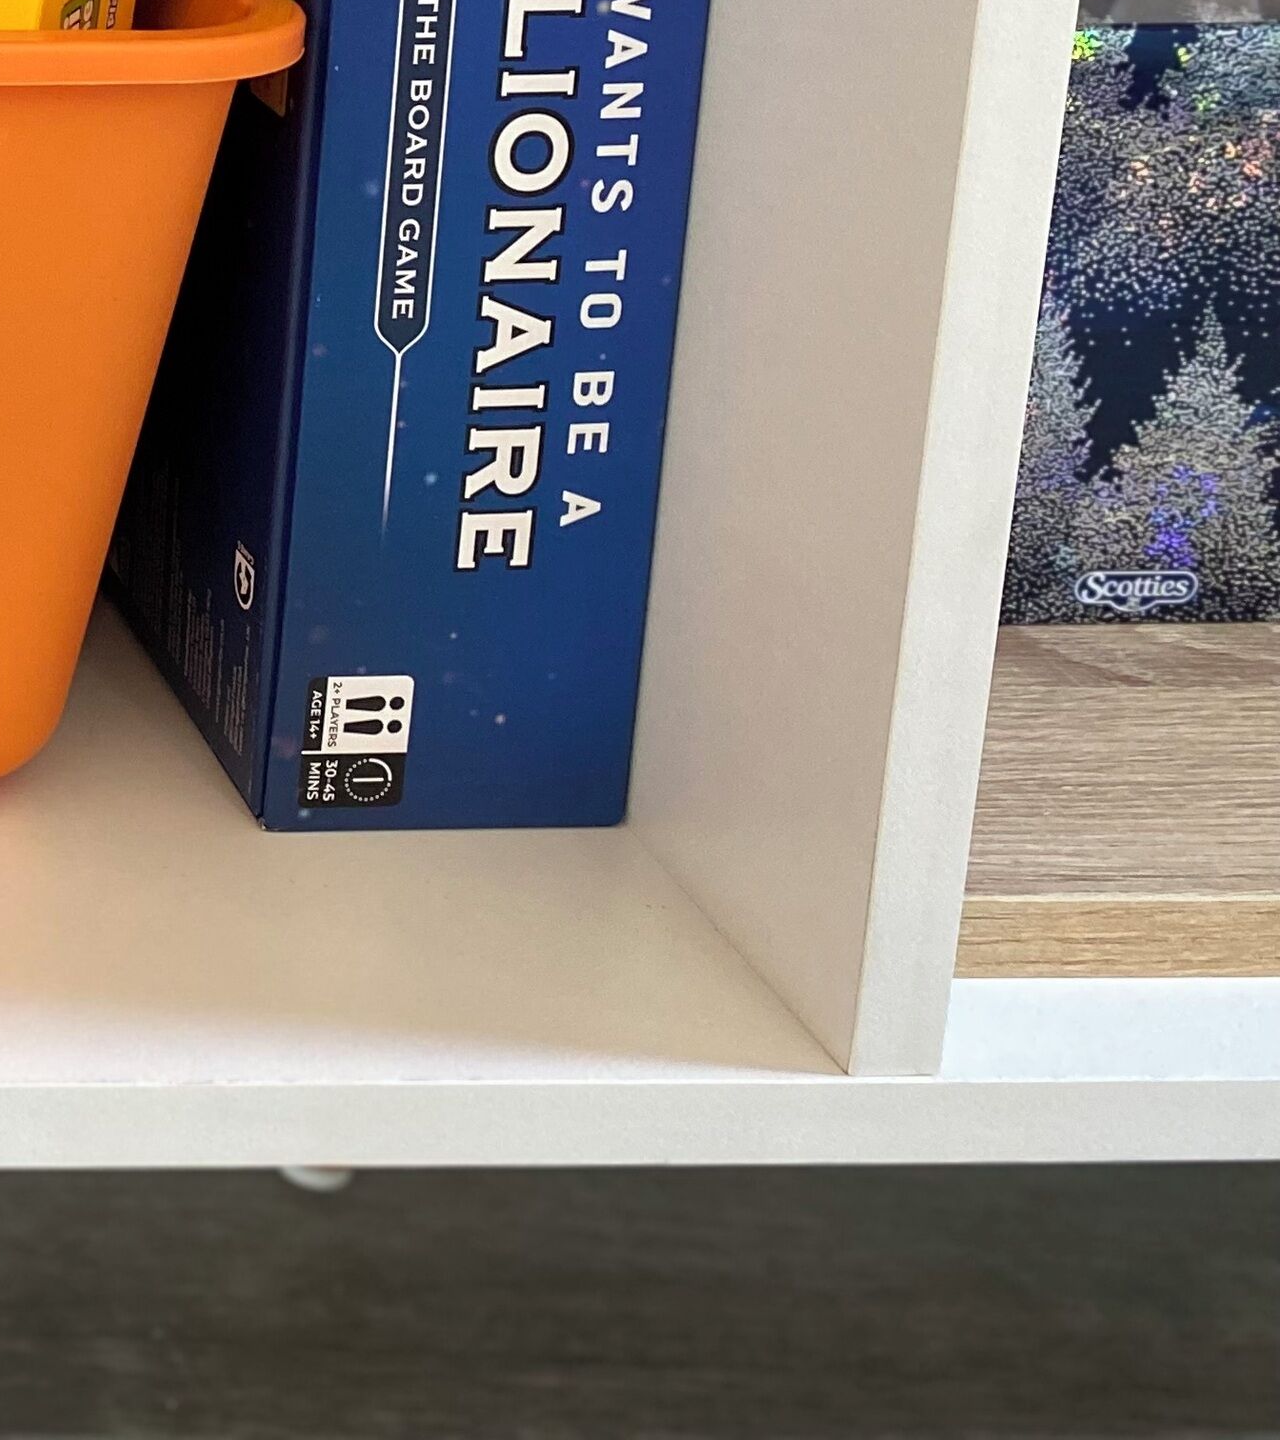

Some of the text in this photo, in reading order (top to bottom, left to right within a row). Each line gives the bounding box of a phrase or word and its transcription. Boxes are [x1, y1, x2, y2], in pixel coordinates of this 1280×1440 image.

[400, 77, 433, 207] BOARD
[391, 217, 422, 322] GAME
[578, 248, 627, 330] TO
[566, 369, 616, 455] BE
[560, 490, 602, 528] A
[1081, 571, 1190, 603] Scotties
[308, 689, 323, 741] AGE 14+
[326, 680, 344, 749] 2+ PLAYERS
[306, 761, 321, 801] MINS
[322, 759, 338, 802] 30-45
